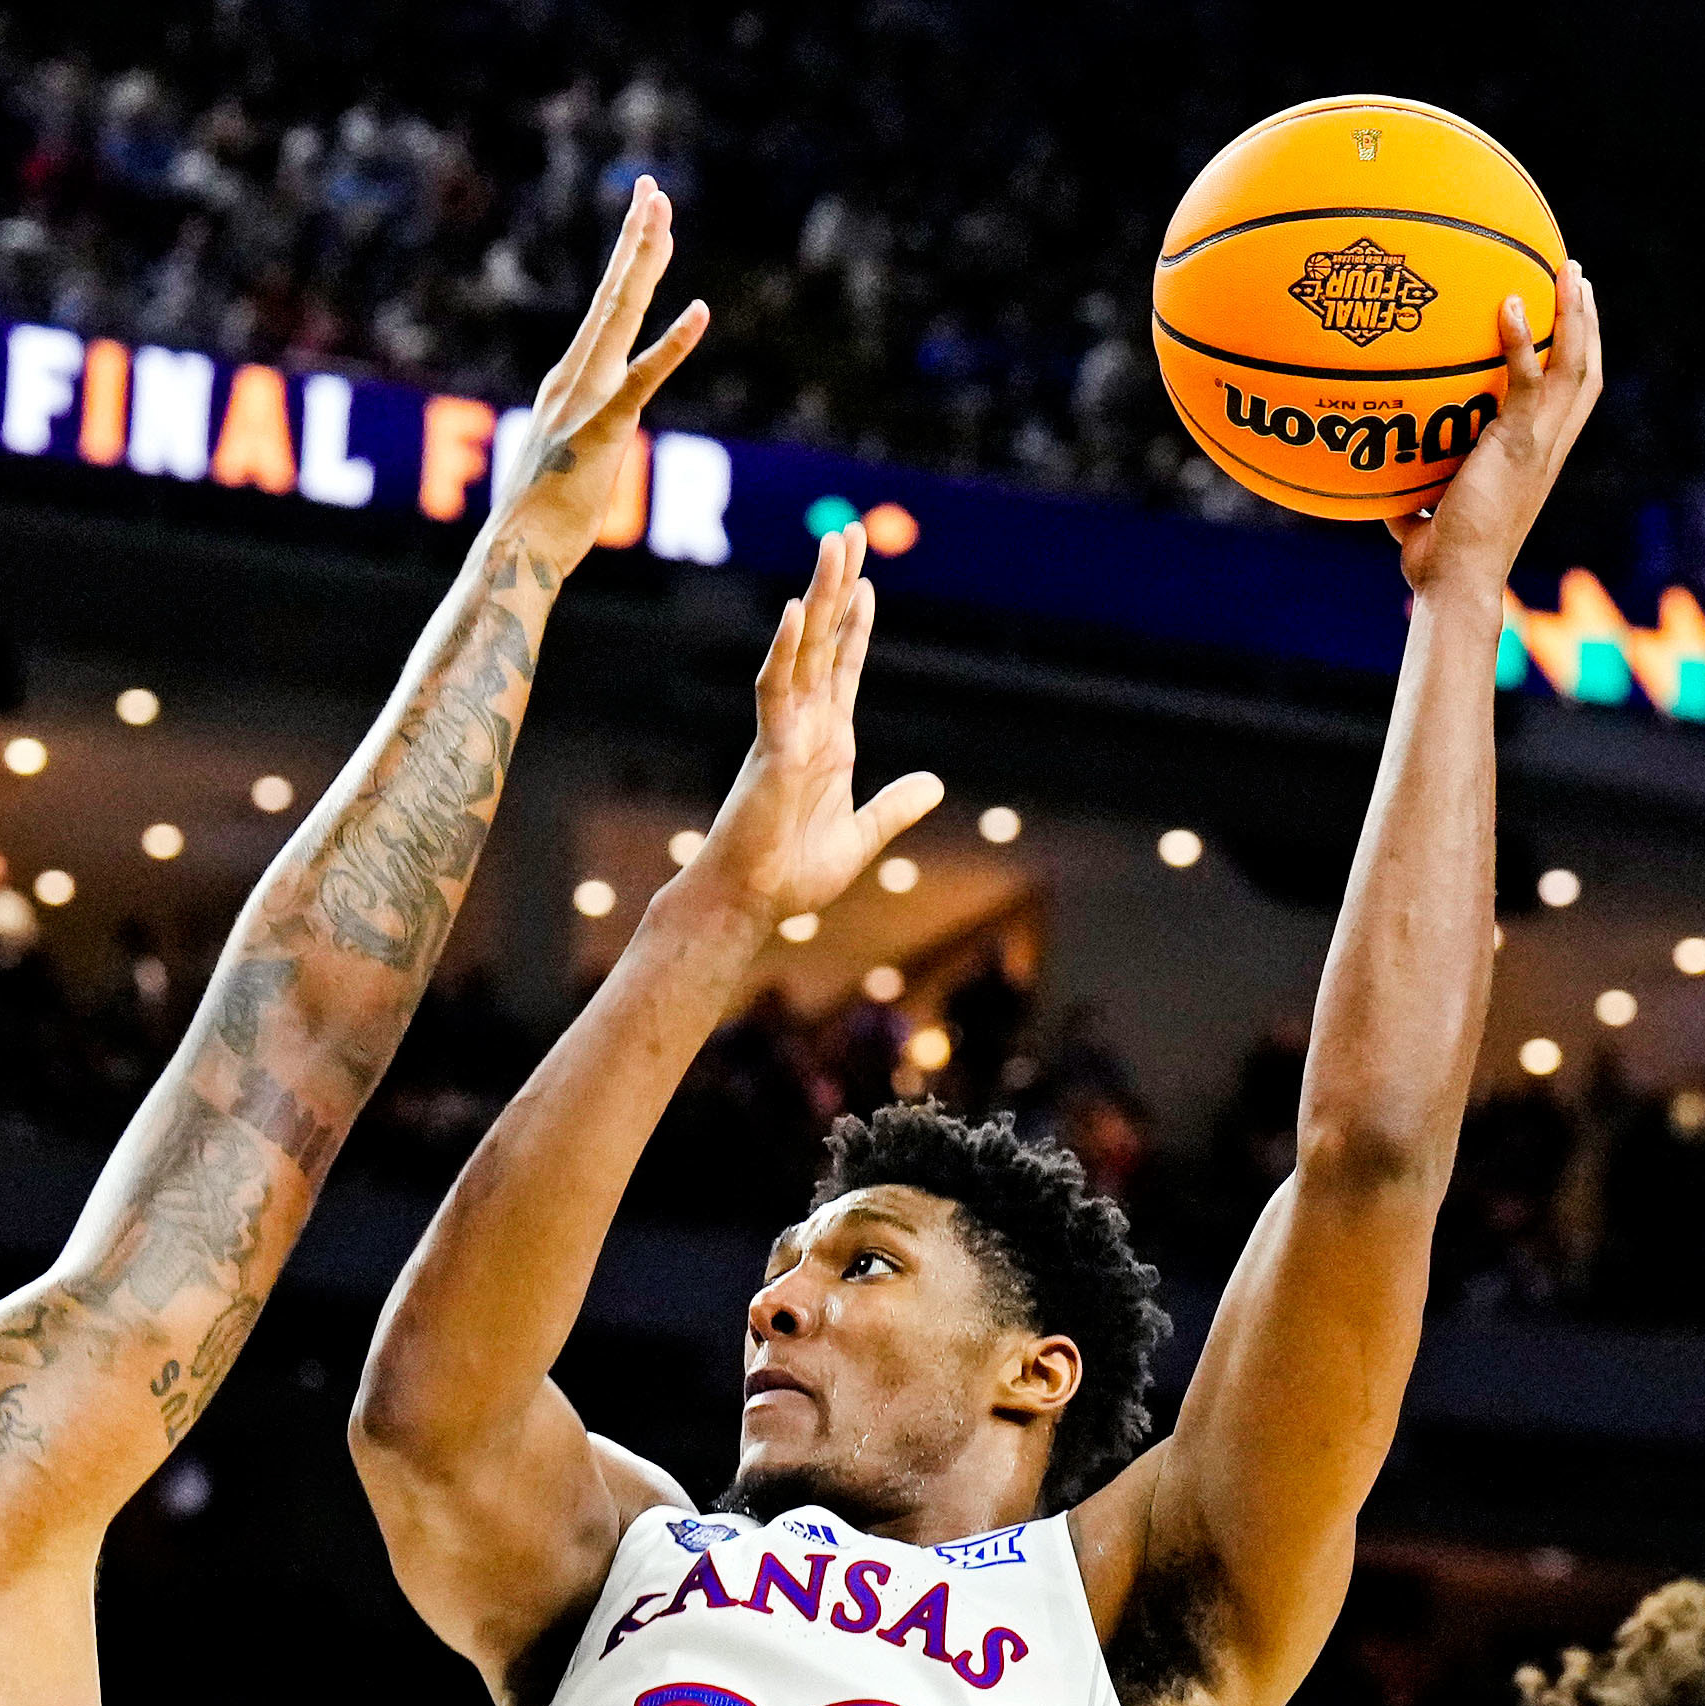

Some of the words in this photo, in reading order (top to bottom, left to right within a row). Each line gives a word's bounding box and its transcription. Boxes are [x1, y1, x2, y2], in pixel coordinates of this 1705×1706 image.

[1324, 270, 1400, 299] FOUR
[1323, 301, 1396, 329] FINAL
[1314, 398, 1355, 410] NXT
[1362, 399, 1403, 411] EVO
[1224, 382, 1499, 472] Wilson
[0, 322, 376, 508] FINAL
[420, 395, 732, 566] FUR
[599, 1551, 1029, 1689] KANSAS
